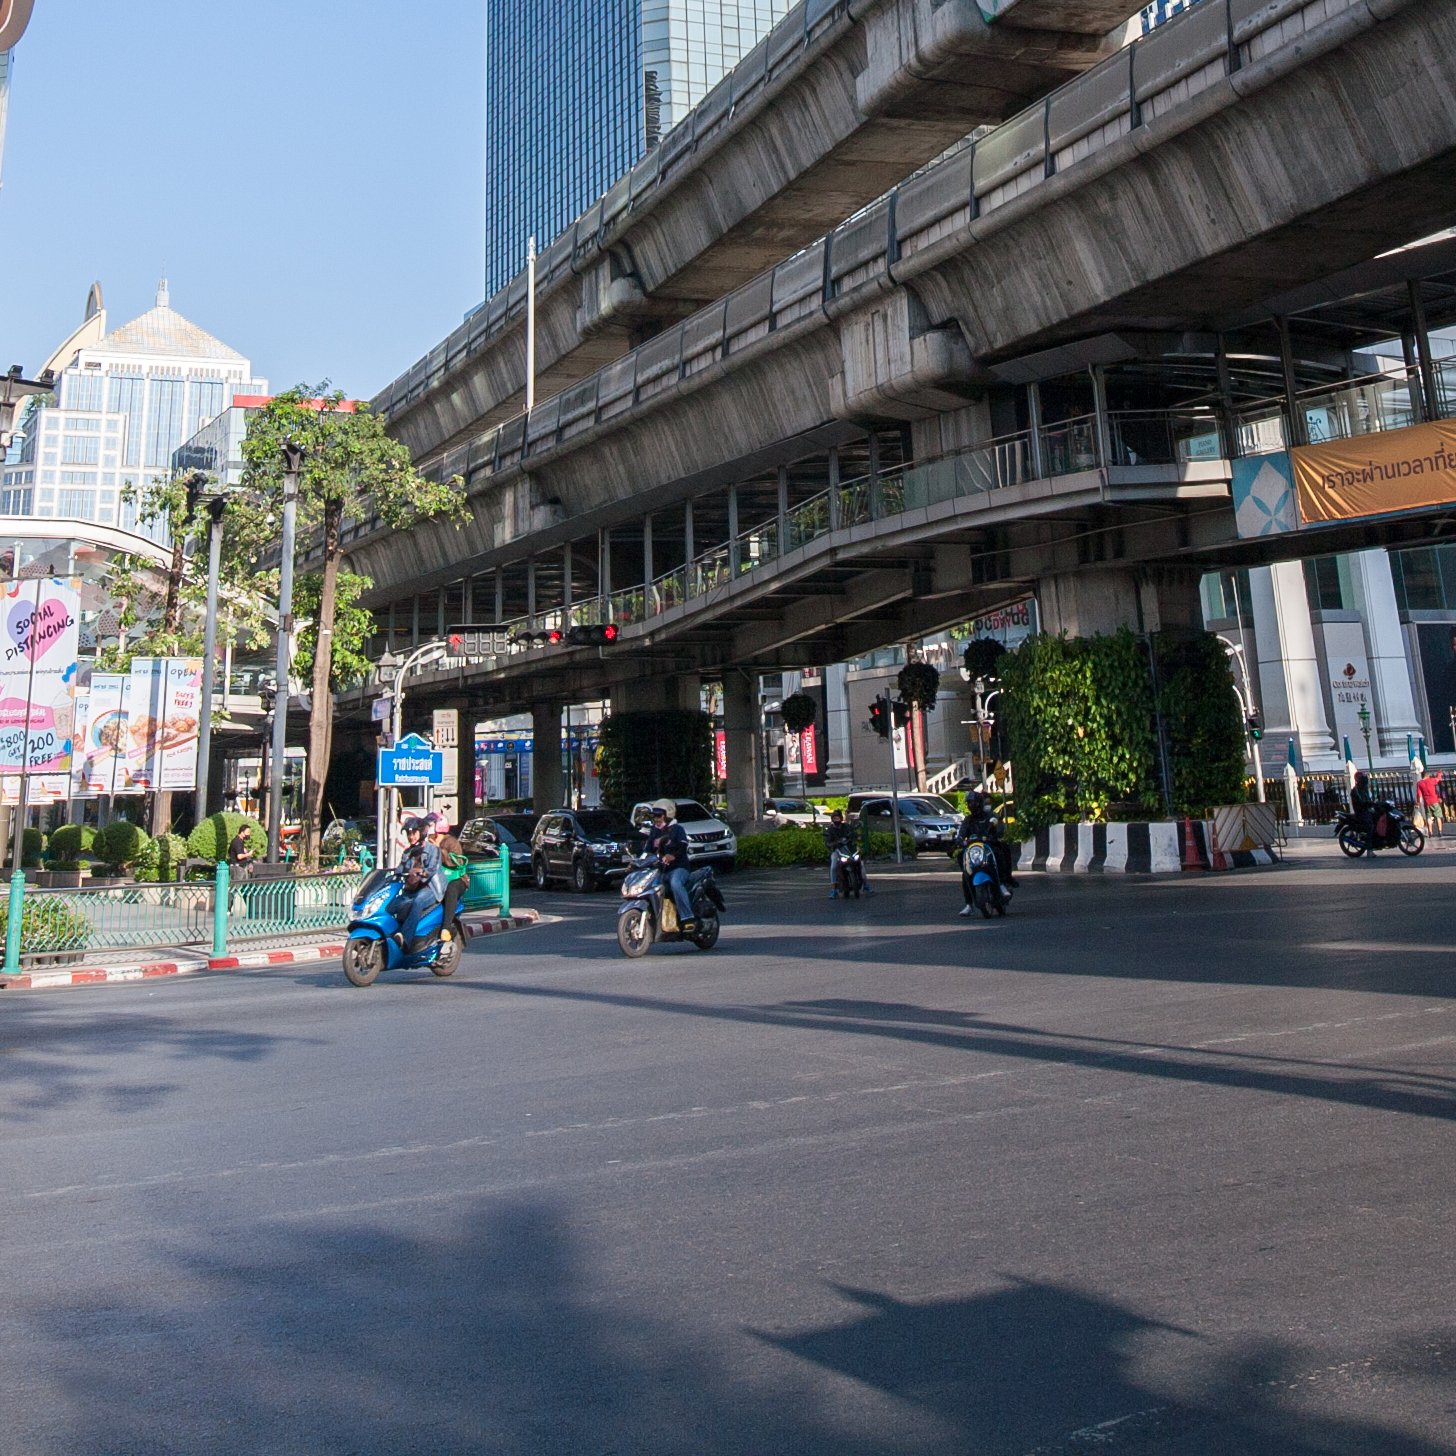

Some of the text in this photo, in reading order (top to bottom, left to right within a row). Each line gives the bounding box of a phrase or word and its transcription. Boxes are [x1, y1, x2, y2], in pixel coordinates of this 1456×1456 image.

[15, 605, 55, 635] SOCIAL
[170, 667, 197, 680] OPEN
[5, 730, 26, 749] 800
[8, 732, 54, 758] GET 200
[29, 752, 54, 769] FREE
